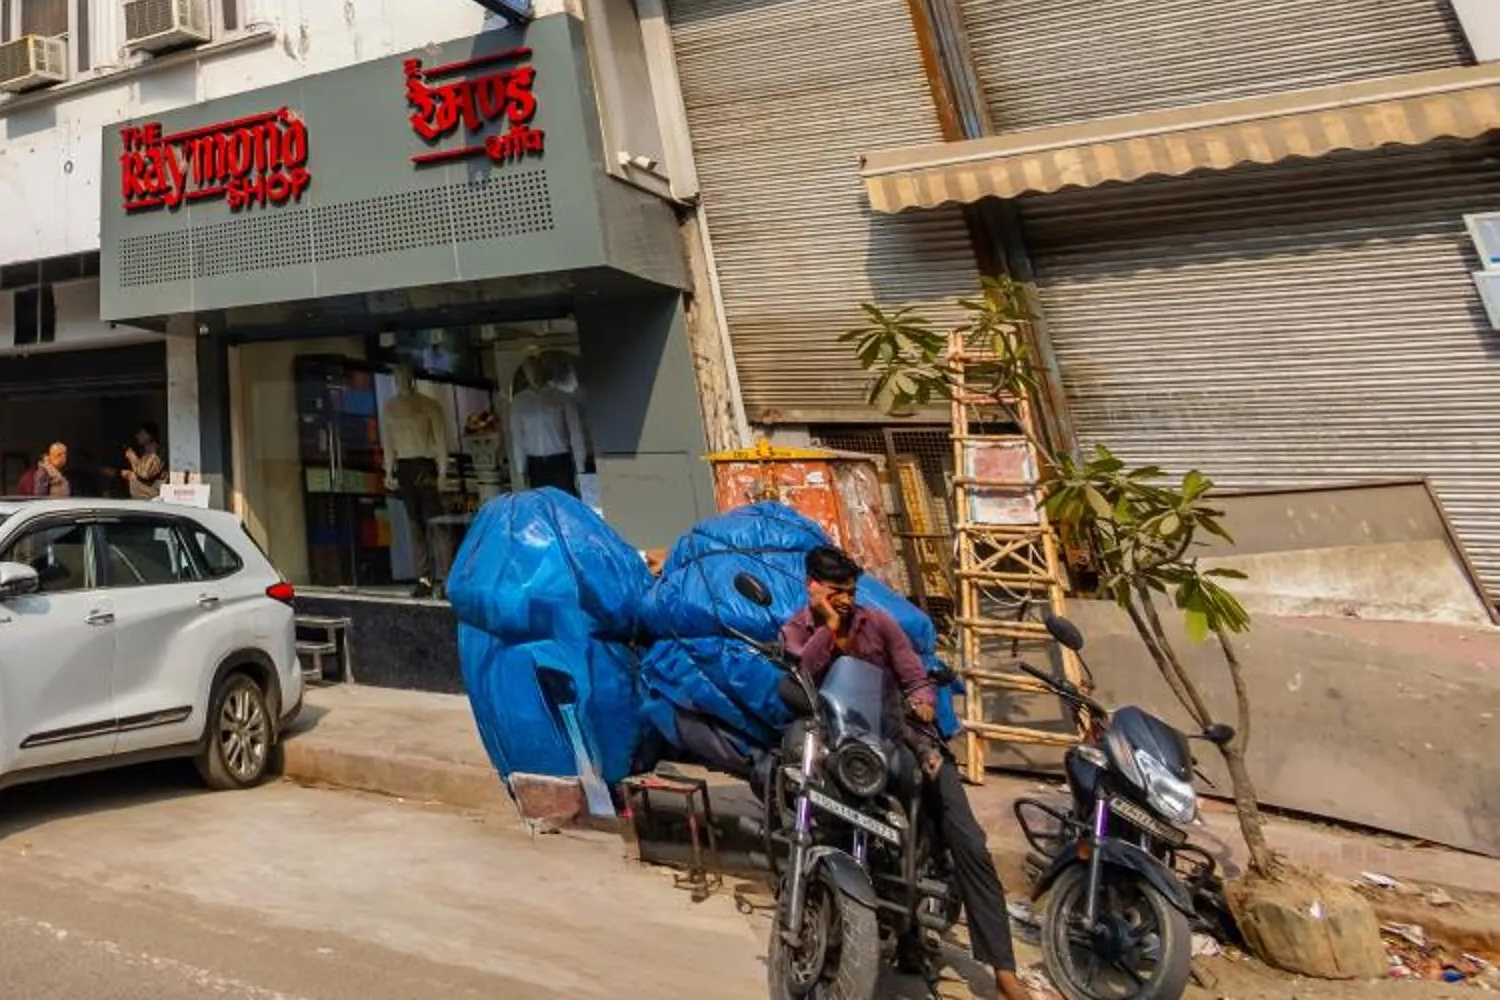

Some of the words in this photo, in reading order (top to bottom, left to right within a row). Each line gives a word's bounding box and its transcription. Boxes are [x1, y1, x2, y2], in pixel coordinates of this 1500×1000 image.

[121, 121, 163, 149] THE
[120, 107, 309, 207] Raymond
[227, 168, 311, 209] SHOP
